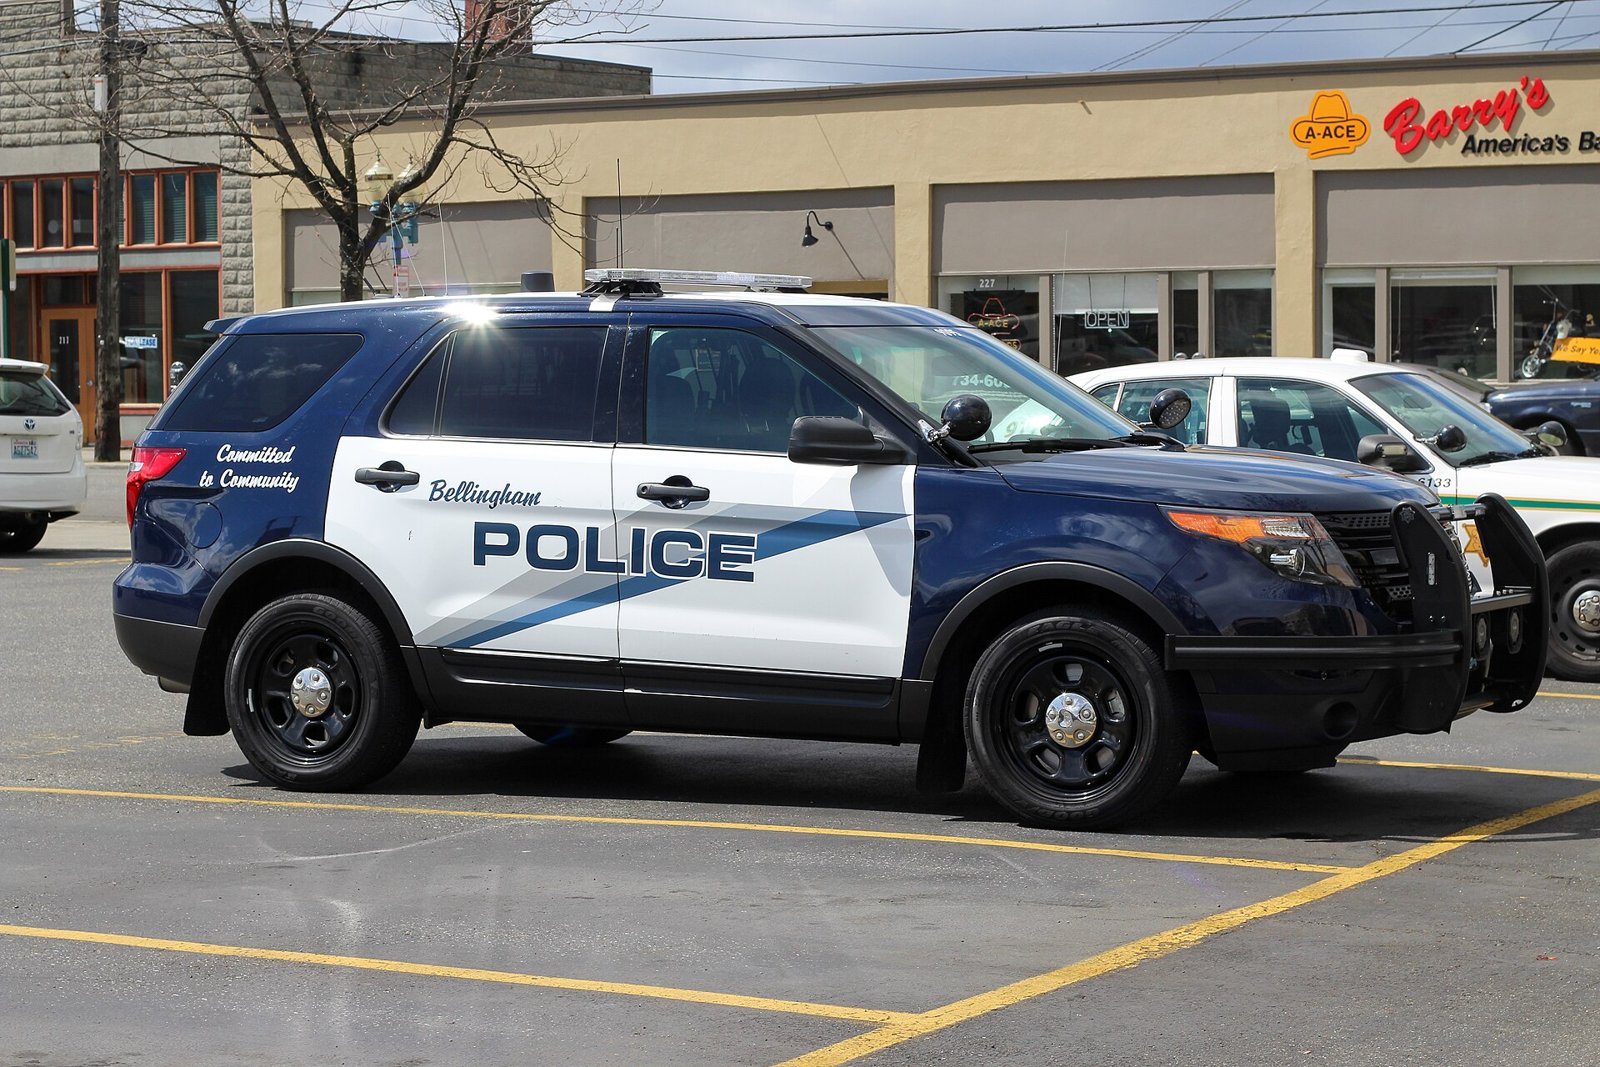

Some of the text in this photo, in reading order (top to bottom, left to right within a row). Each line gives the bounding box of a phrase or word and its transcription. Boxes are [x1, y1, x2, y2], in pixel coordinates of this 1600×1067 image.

[1384, 75, 1550, 154] Barry's
[1305, 124, 1356, 140] A-ACE
[1461, 133, 1570, 154] America's
[979, 278, 996, 289] 227
[977, 319, 1009, 329] A-ACE
[1086, 311, 1128, 327] OPEN
[139, 337, 156, 347] LEASE
[216, 443, 296, 464] Committed
[199, 468, 300, 493] to Community
[428, 478, 543, 509] Bellingham
[472, 520, 759, 583] POLICE
